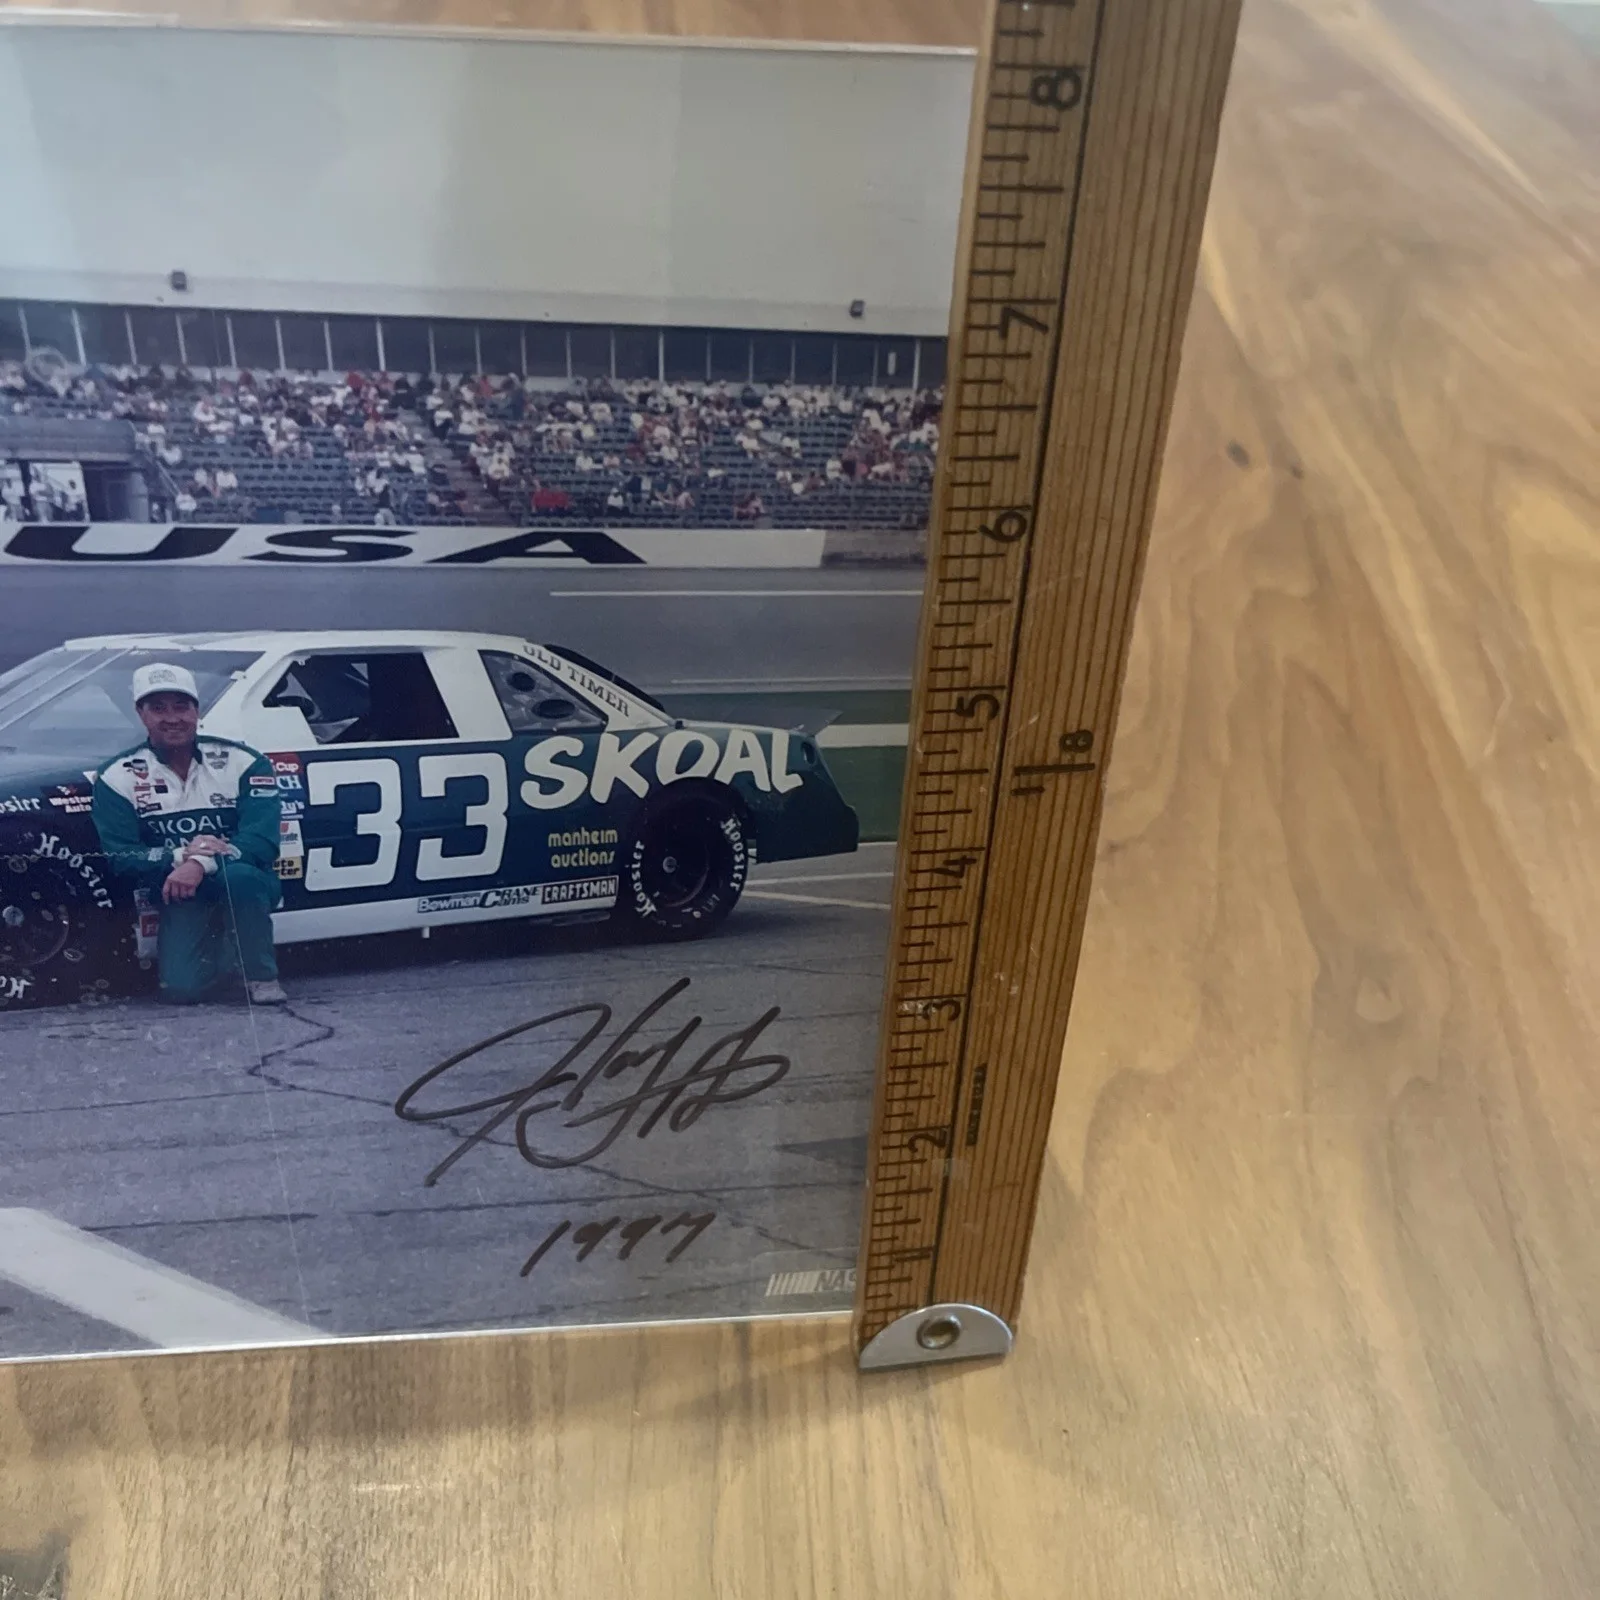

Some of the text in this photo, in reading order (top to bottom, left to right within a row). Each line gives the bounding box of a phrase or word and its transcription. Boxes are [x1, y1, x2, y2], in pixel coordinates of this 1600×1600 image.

[1030, 67, 1083, 111] 8
[1000, 304, 1050, 341] 7
[978, 507, 1028, 544] 6
[3, 525, 648, 564] USA
[567, 665, 630, 718] TIMER
[955, 693, 1001, 721] 5
[275, 761, 299, 773] Cup
[520, 729, 804, 810] SKOAL
[147, 814, 230, 835] SKOAL
[304, 752, 509, 892] 33
[548, 826, 618, 848] manheim
[551, 850, 616, 869] auctions
[932, 855, 978, 878] 4
[543, 878, 616, 902] CRAFTSMAN
[922, 997, 962, 1022] 3
[908, 1127, 948, 1154] 2
[520, 1211, 716, 1278] 1997
